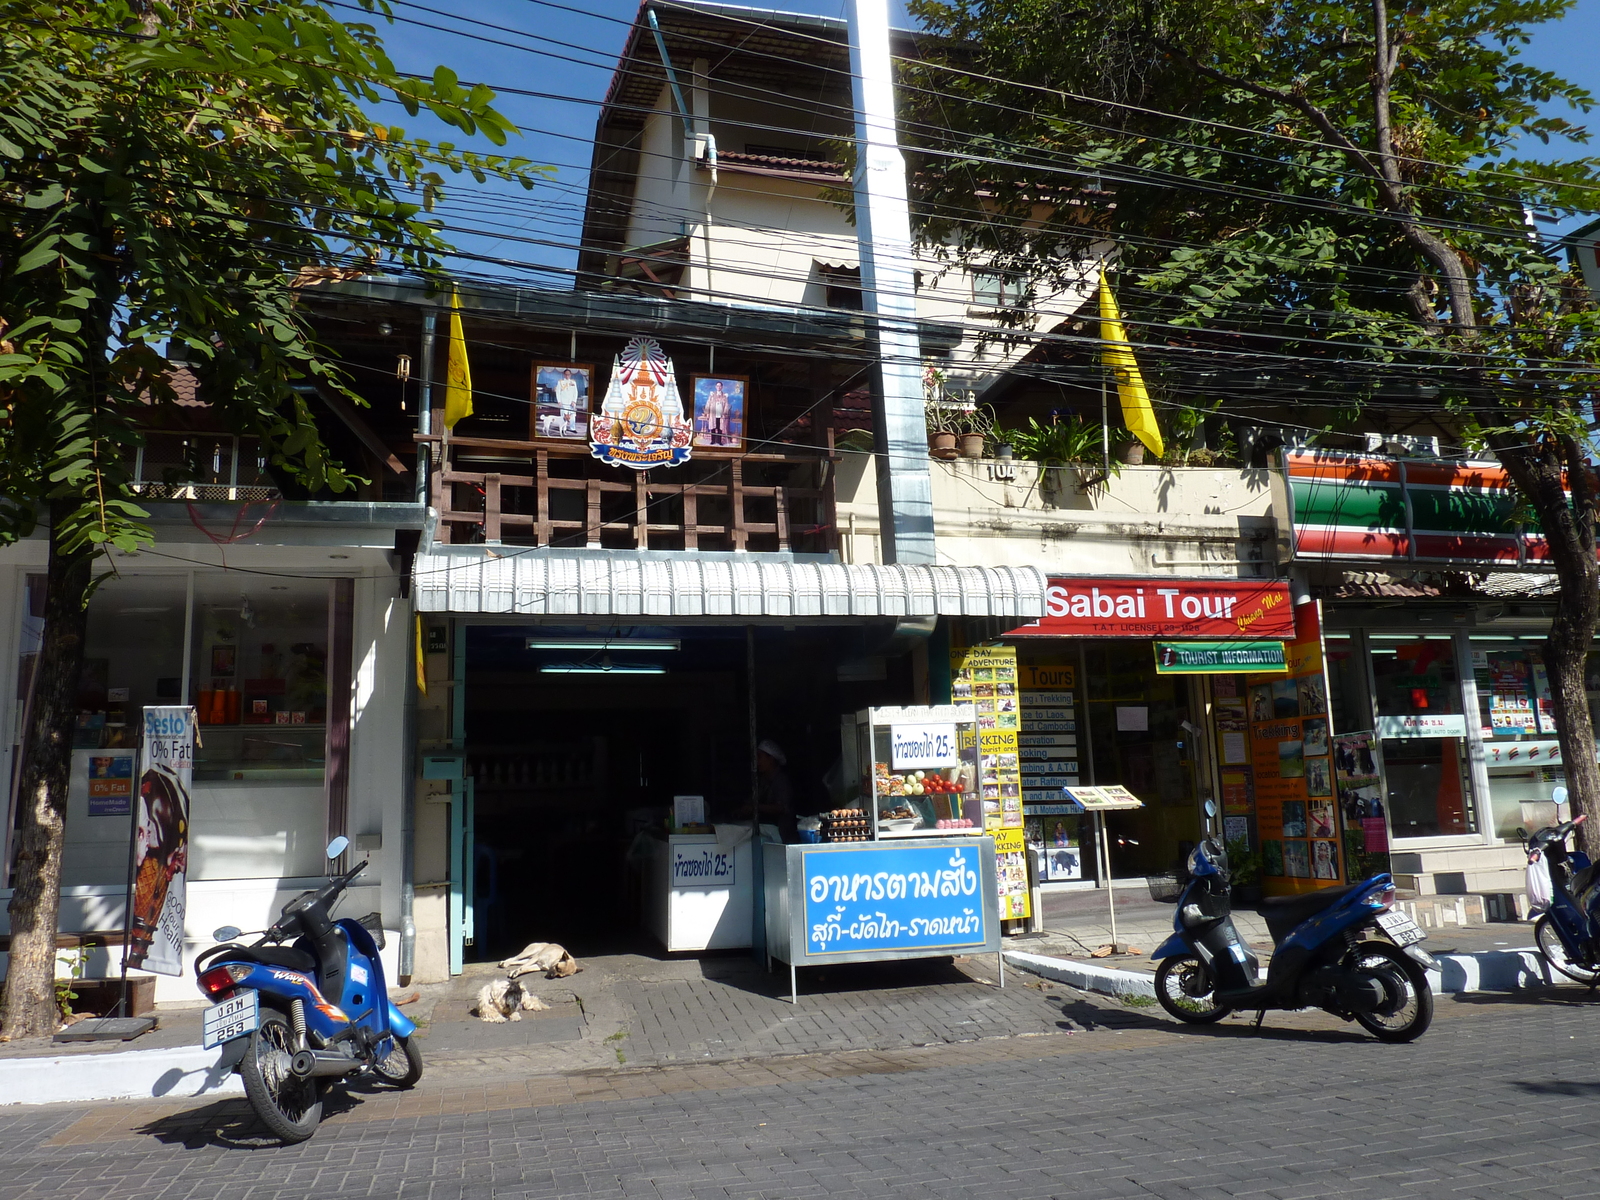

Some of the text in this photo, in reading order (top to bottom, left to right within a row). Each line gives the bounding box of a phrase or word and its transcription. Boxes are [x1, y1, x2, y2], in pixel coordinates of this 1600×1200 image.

[608, 447, 673, 461] ทรงพระเจริญ
[1046, 586, 1237, 619] Sabai Tour
[1237, 591, 1283, 631] Chiang Mai
[950, 649, 992, 658] ONE DAY
[1178, 650, 1218, 665] TOURIST
[1222, 649, 1284, 665] INFORMATION
[967, 658, 1014, 667] ADVENTURE
[1029, 666, 1073, 685] Tours
[1039, 694, 1072, 705] Trekking
[1035, 710, 1043, 719] to
[1037, 721, 1075, 730] Cambodia
[1252, 725, 1299, 738] Trekking
[151, 740, 191, 759] 0% Fat
[894, 731, 934, 759] ข้าวซอยไก่
[1048, 763, 1054, 772] &
[94, 783, 126, 792] 0% Fat
[1040, 777, 1068, 787] Rafting
[674, 850, 713, 877] ข้าวซอยไก่
[810, 847, 978, 903] อาหารตามสั่ง
[166, 890, 186, 921] GOOD
[158, 912, 183, 956] Health
[273, 970, 304, 982] Wave
[216, 1022, 244, 1041] 253
